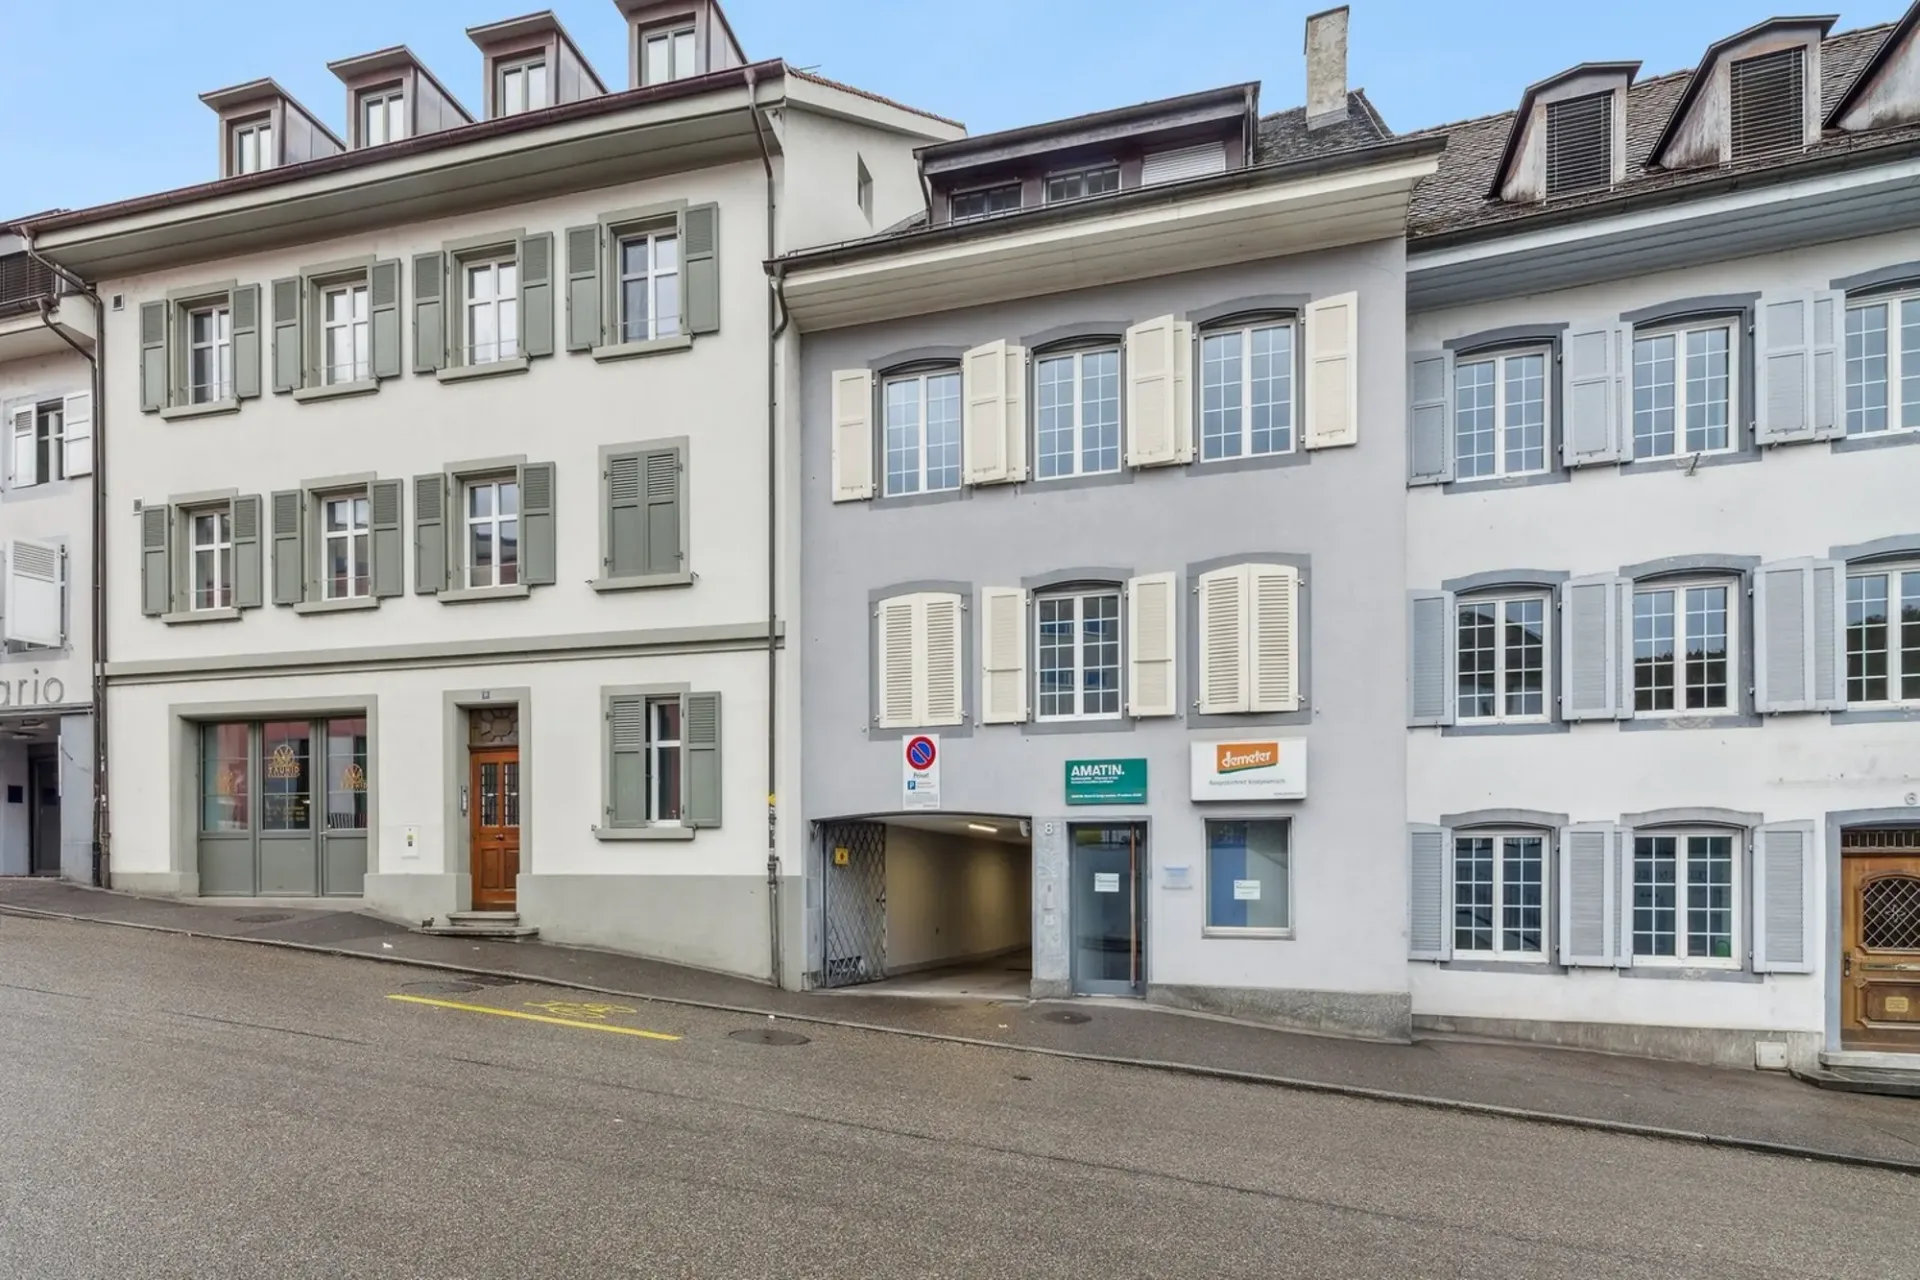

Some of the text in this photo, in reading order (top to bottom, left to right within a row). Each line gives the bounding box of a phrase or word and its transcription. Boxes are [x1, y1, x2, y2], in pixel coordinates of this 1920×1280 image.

[1222, 750, 1271, 767] demeter
[1071, 764, 1125, 776] AMATIN.
[1045, 822, 1053, 835] 8
